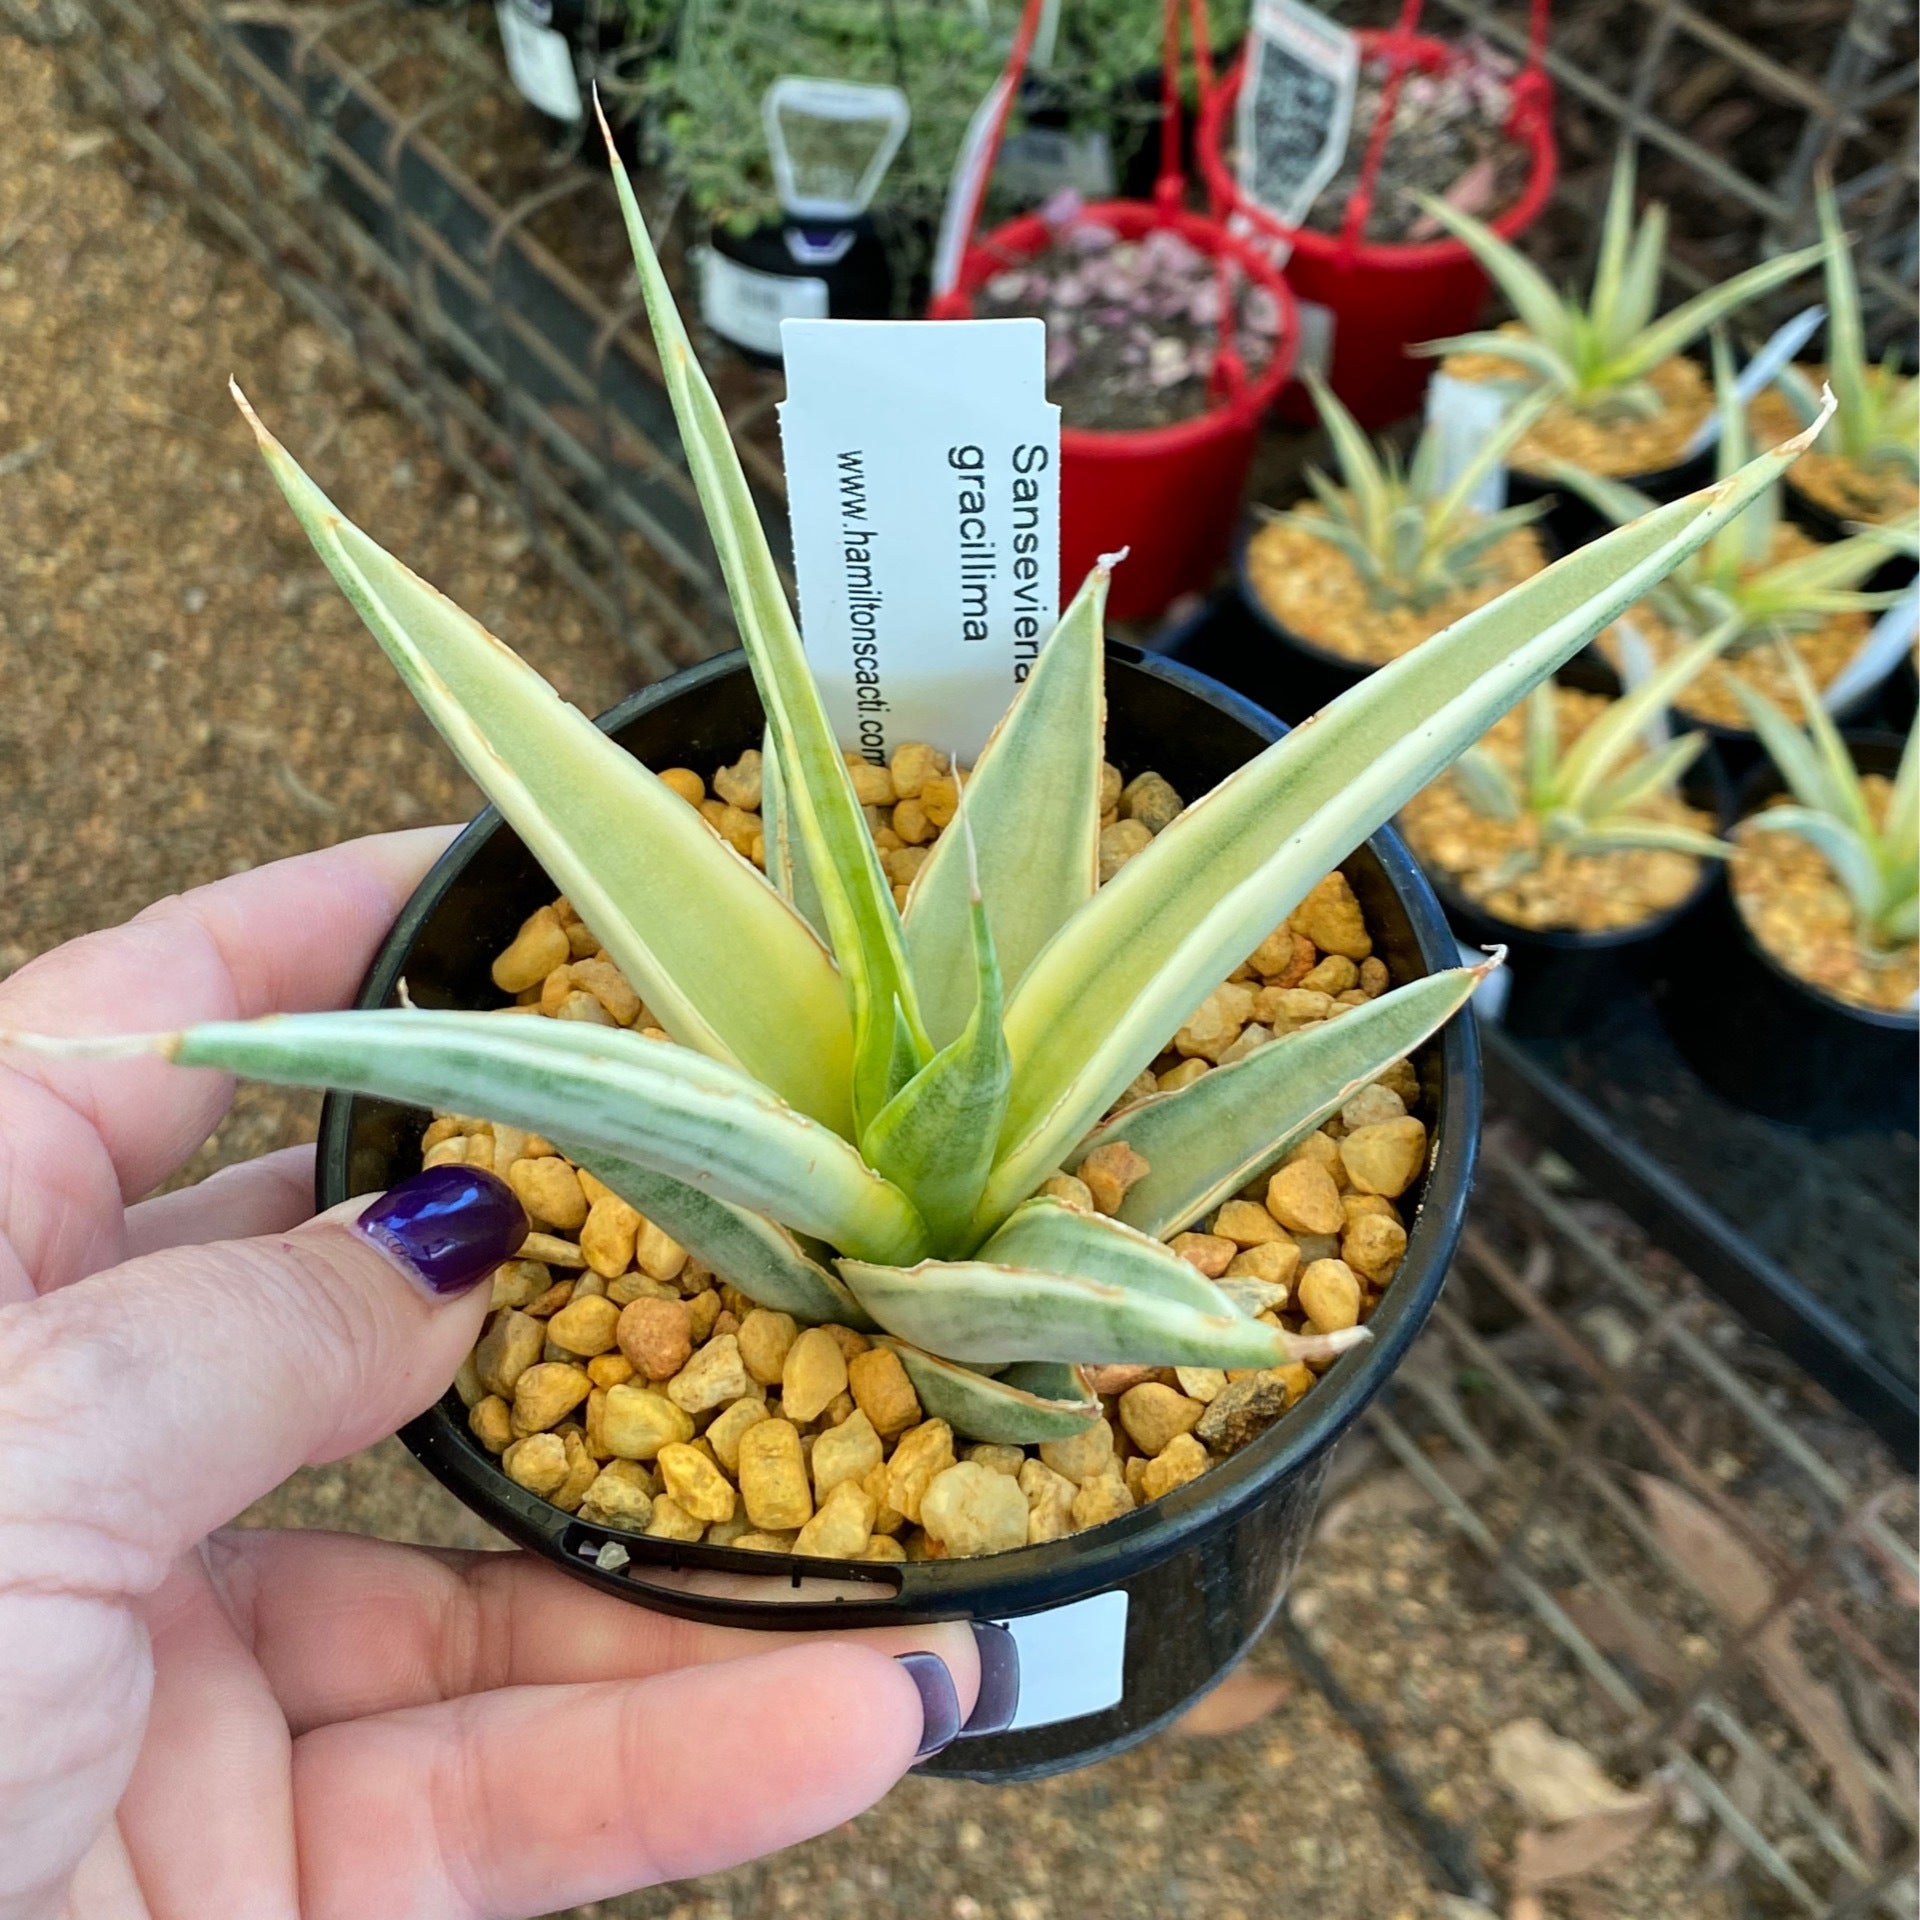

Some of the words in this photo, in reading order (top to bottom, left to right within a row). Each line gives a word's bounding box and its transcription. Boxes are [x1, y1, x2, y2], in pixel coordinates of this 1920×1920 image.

[837, 450, 891, 767] www.hamiltonscacti.com
[948, 445, 996, 641] gracillima
[1012, 444, 1048, 683] Sansevieria
